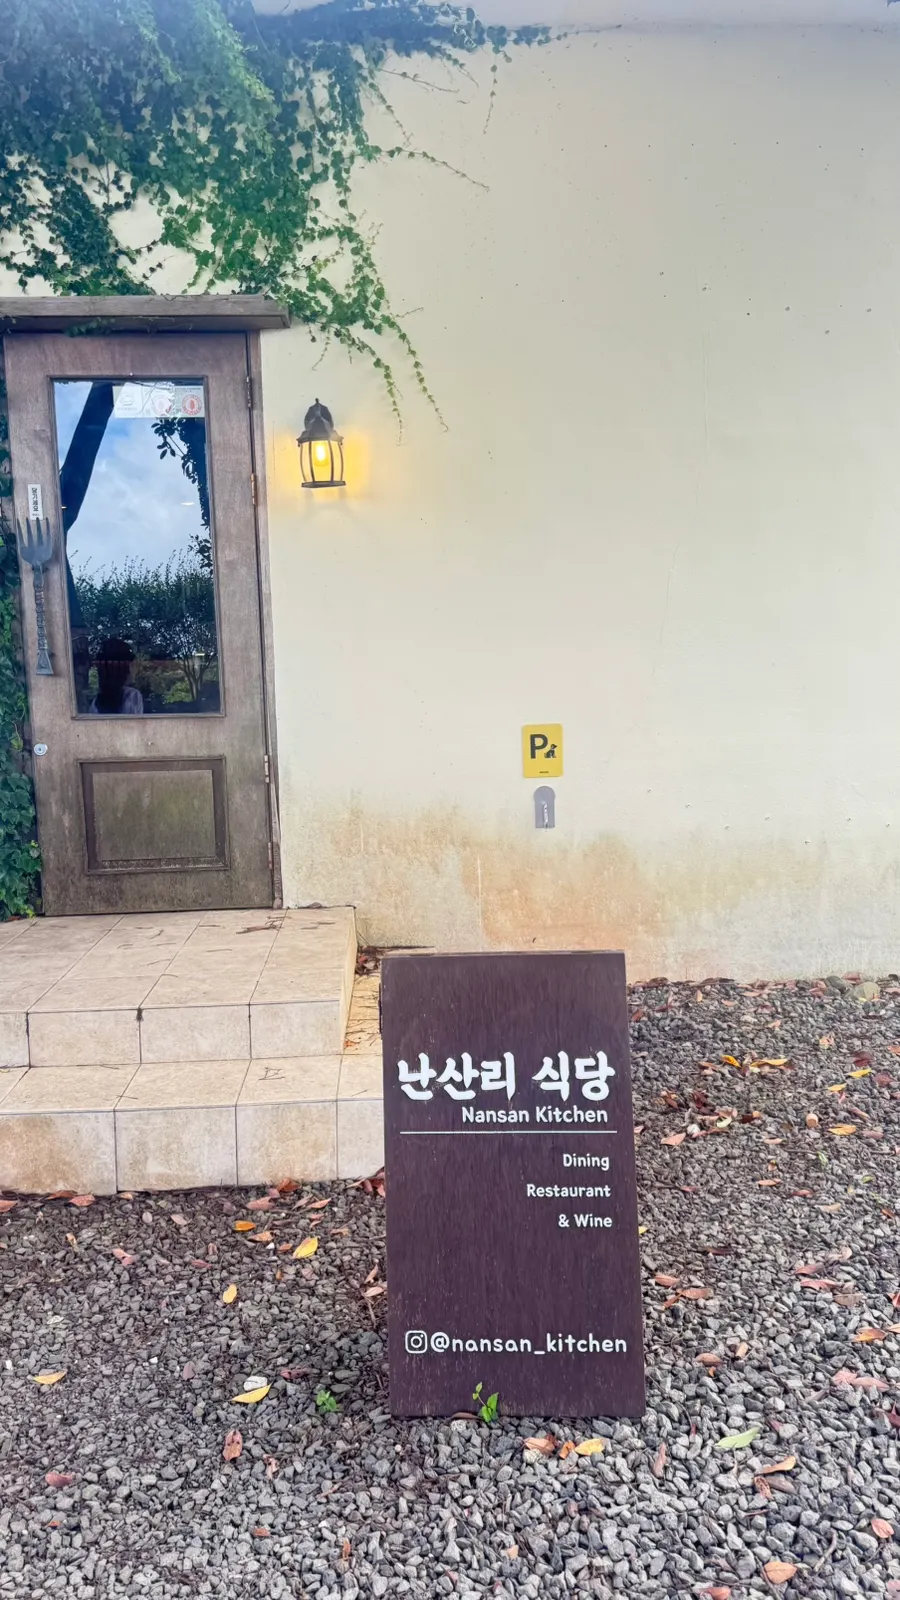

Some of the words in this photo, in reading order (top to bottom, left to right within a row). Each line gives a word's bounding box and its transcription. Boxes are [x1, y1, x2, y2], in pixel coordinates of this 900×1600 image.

[530, 734, 548, 759] P
[397, 1051, 516, 1101] 난산리
[532, 1050, 616, 1102] 식당
[461, 1106, 530, 1123] Nansan
[535, 1104, 608, 1123] Kitchen
[562, 1153, 610, 1171] Dining
[526, 1183, 611, 1198] Restaurant
[558, 1213, 570, 1228] &
[574, 1213, 613, 1228] Wine
[430, 1331, 627, 1355] @nansan_kitchen
